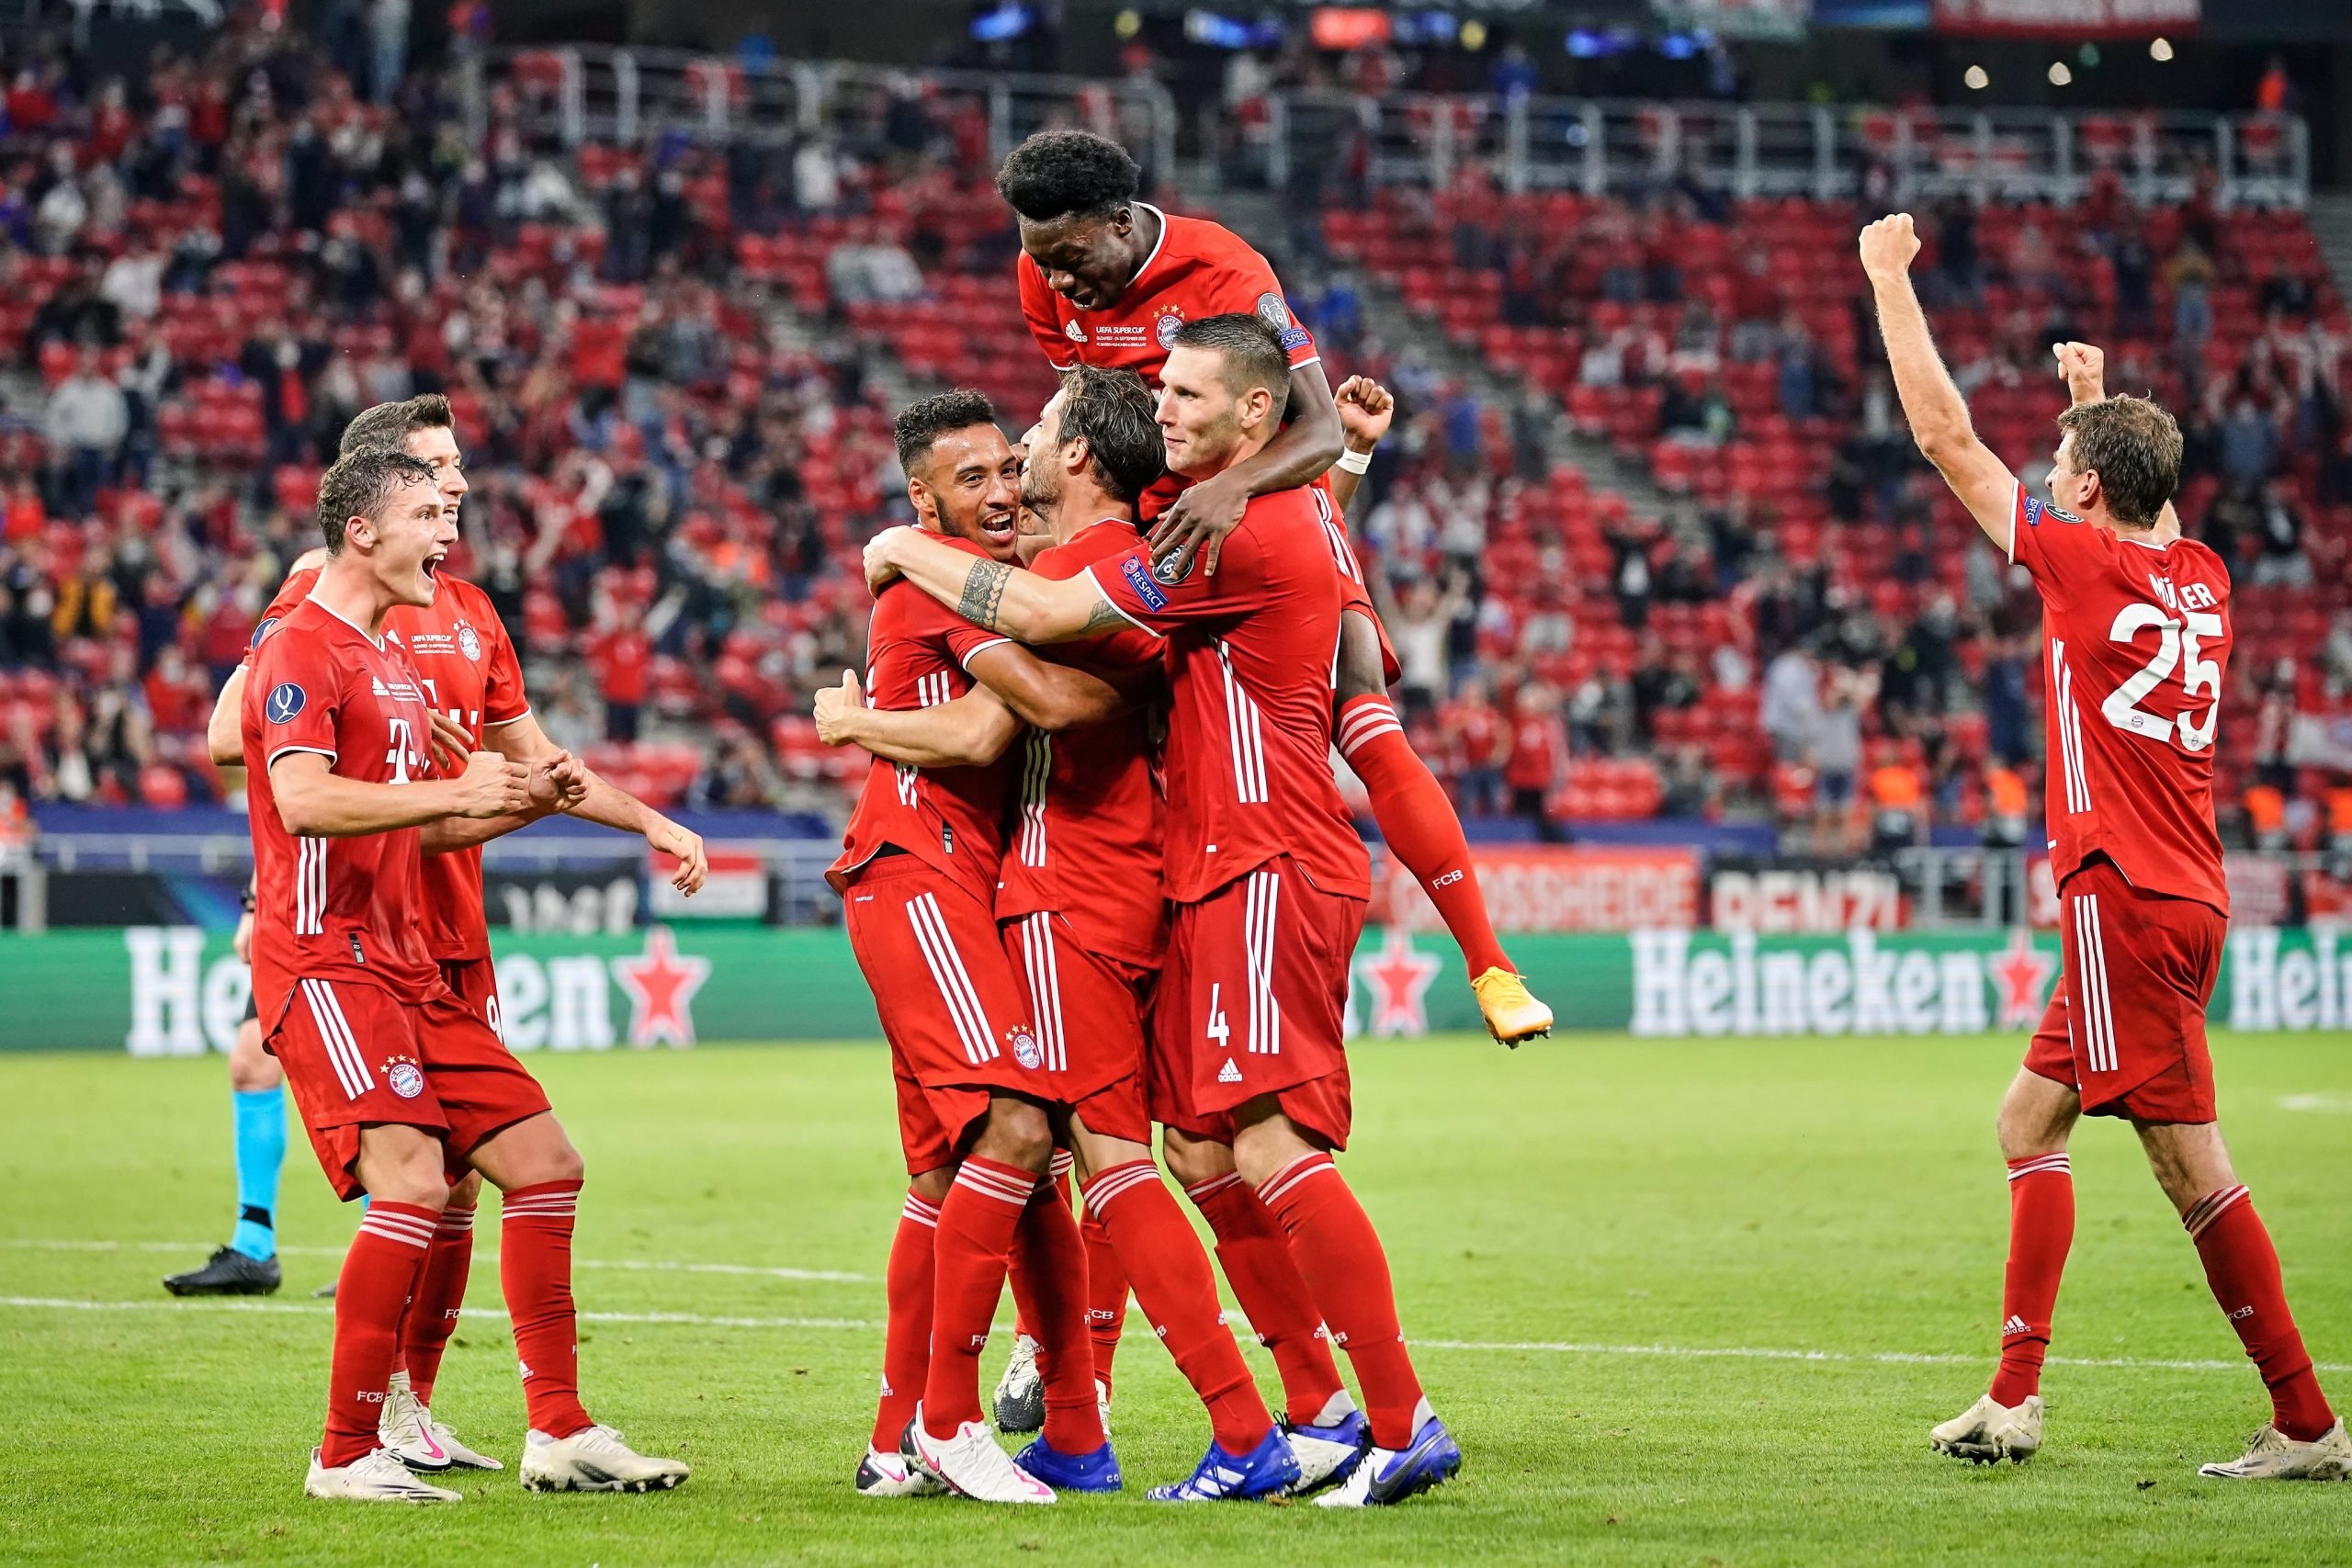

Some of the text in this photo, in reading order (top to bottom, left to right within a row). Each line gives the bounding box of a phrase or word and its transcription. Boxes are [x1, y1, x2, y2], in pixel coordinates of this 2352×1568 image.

[1113, 326, 1132, 334] SUPER
[1132, 571, 1164, 608] RESPECT
[2101, 603, 2224, 752] 25
[1432, 869, 1464, 890] FCB
[1630, 924, 1988, 1036] Heineken
[1206, 983, 1230, 1047] 4
[1217, 1073, 1243, 1083] adidas
[2002, 1325, 2031, 1337] adidas
[356, 1391, 384, 1404] FCB
